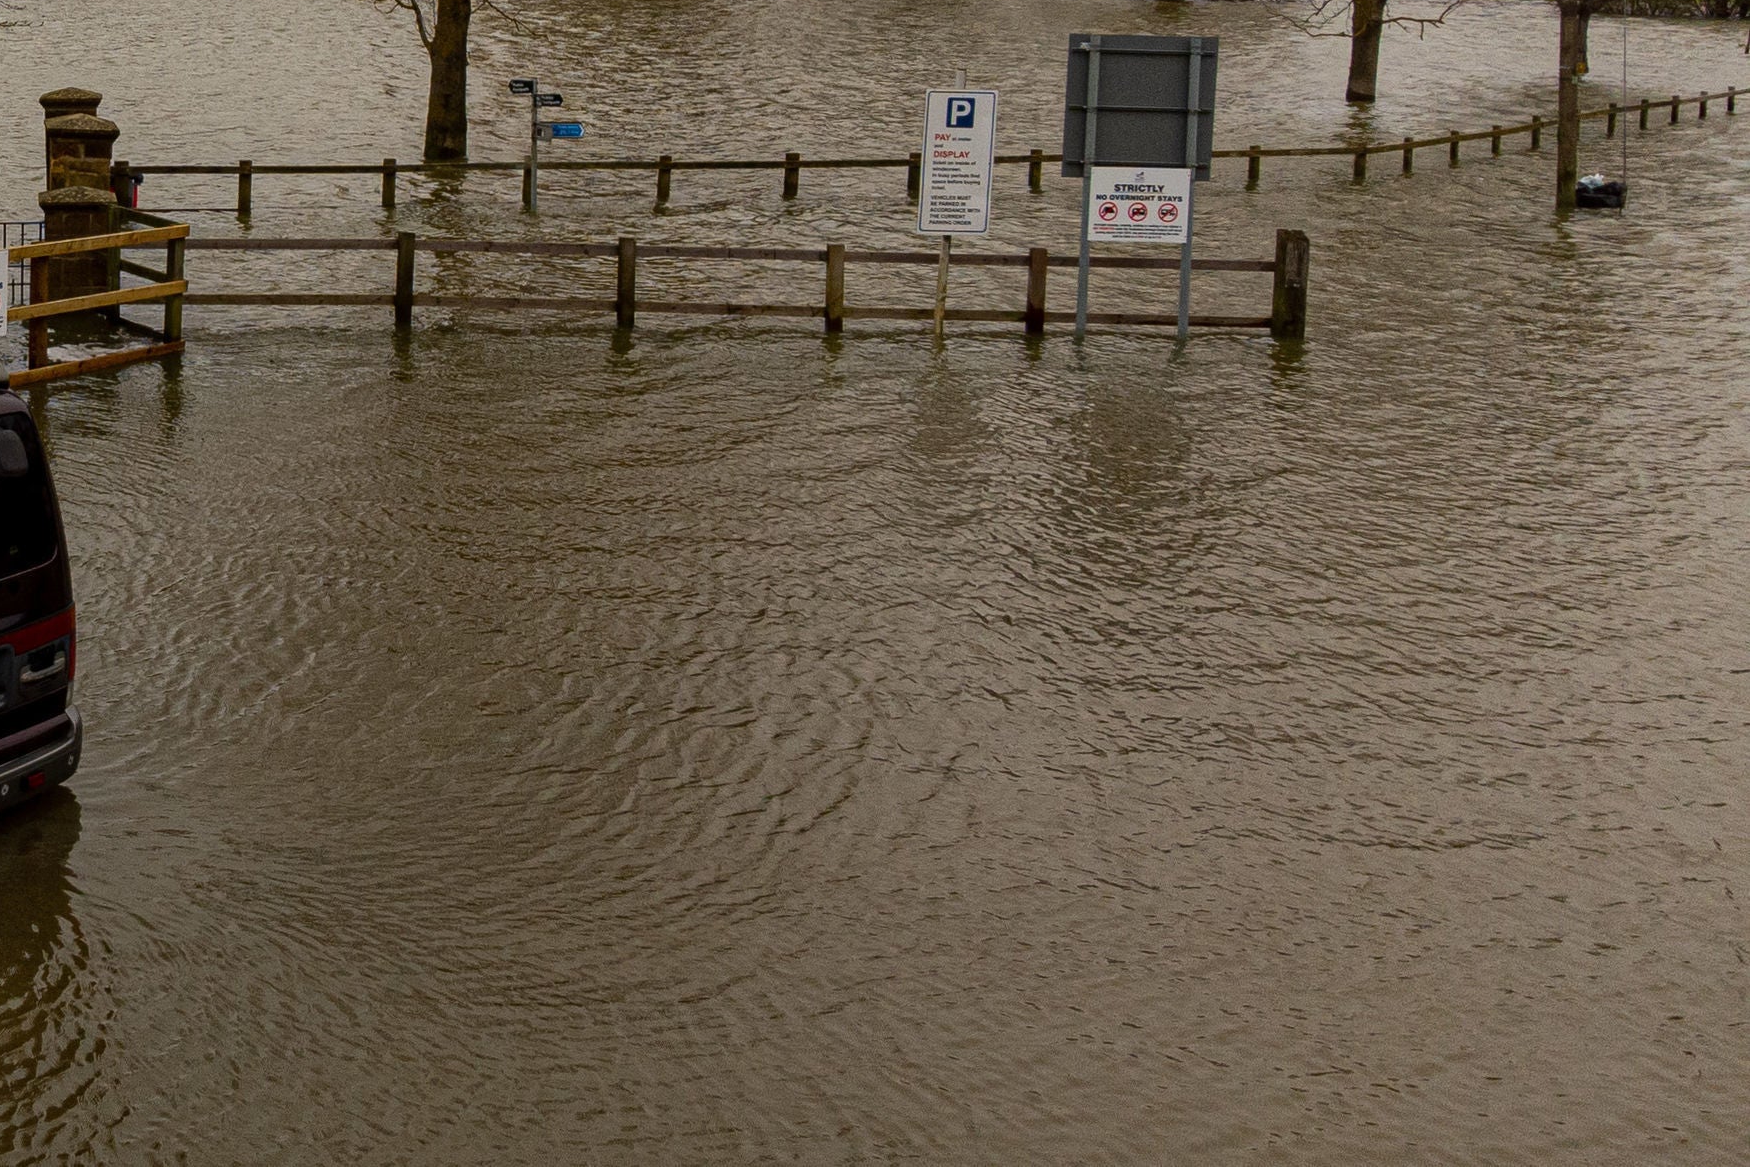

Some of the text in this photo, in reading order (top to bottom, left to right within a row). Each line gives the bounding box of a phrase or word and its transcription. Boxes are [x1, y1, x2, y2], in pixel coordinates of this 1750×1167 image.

[950, 100, 971, 125] P
[934, 133, 951, 141] PAY
[933, 150, 970, 158] DISPLAY
[1114, 183, 1165, 193] STRICTLY
